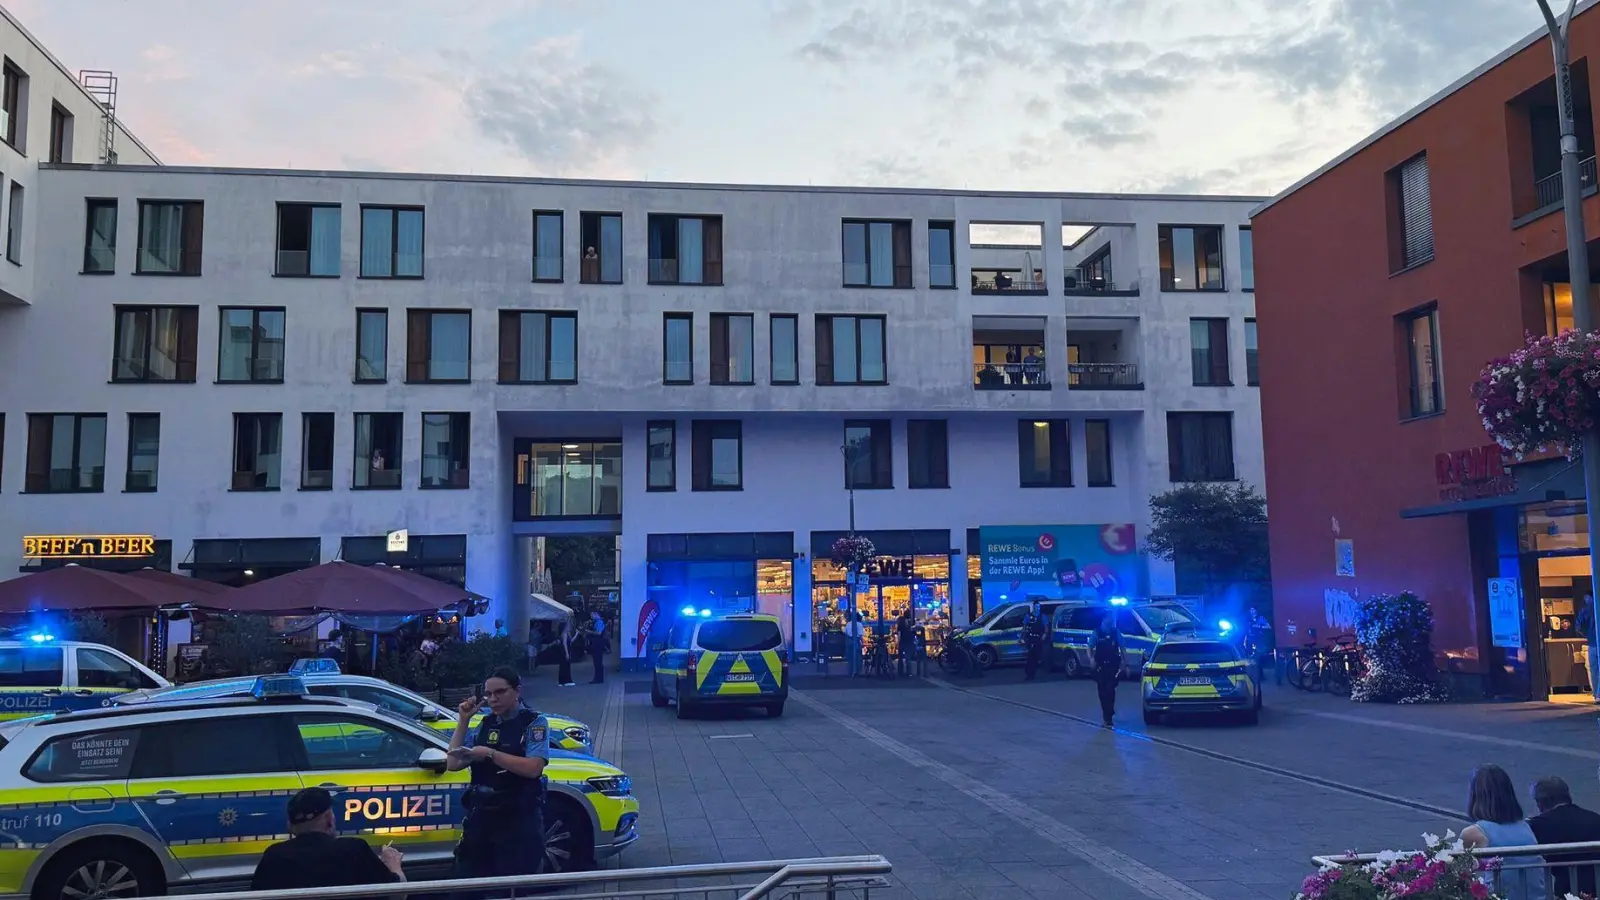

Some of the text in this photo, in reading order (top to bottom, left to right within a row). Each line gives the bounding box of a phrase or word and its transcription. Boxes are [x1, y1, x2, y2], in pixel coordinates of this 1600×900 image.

[1435, 443, 1505, 485] REWE
[100, 537, 155, 554] BEER
[988, 544, 1035, 552] REWE Bonus
[866, 559, 913, 577] EWE
[989, 556, 1049, 565] Sammle Euros in
[989, 565, 1045, 576] der REWE App!
[640, 609, 658, 636] REWE
[72, 738, 130, 750] DAS KÖNNTE DEIN
[77, 747, 123, 758] EINSATZ SEIN!
[344, 794, 451, 821] POLIZEI
[0, 813, 62, 830] truf 110
